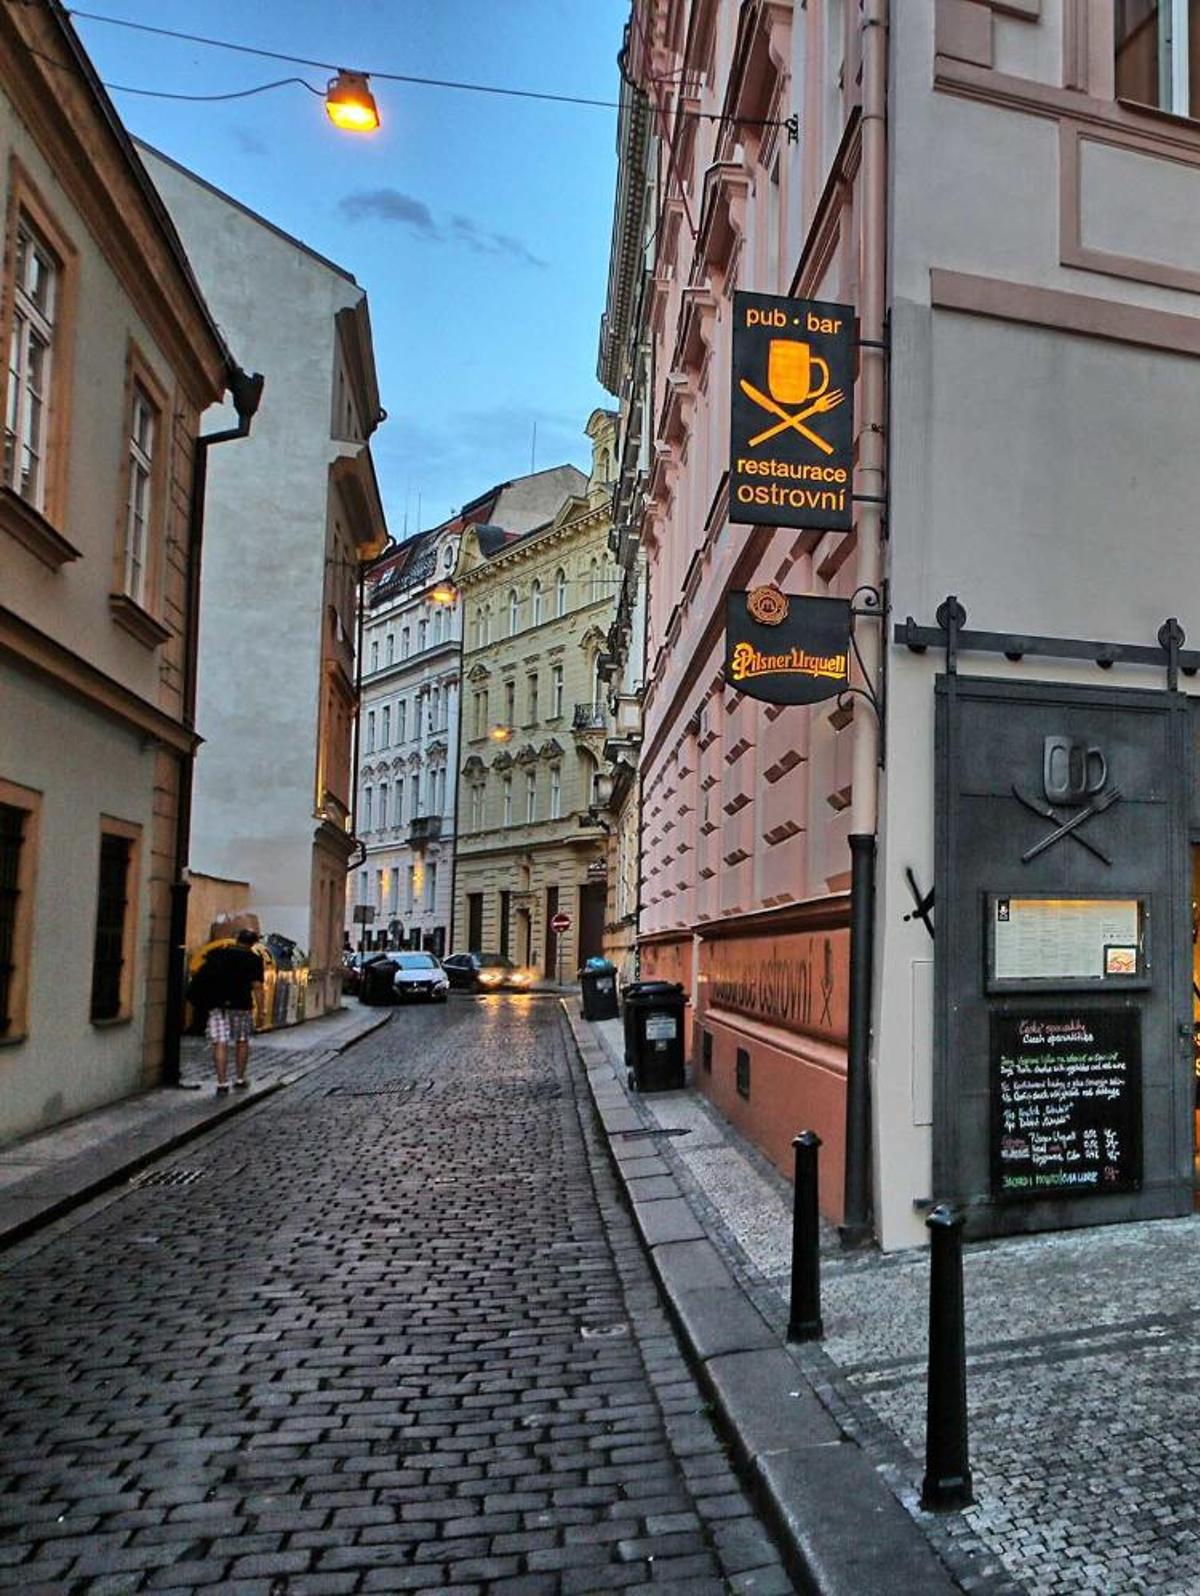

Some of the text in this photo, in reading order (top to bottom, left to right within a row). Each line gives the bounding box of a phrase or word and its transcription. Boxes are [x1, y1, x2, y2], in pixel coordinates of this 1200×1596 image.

[746, 308, 842, 334] pub bar
[738, 458, 847, 483] restaurace
[737, 483, 846, 511] ostrovní
[732, 643, 846, 680] Pilsner Urquell
